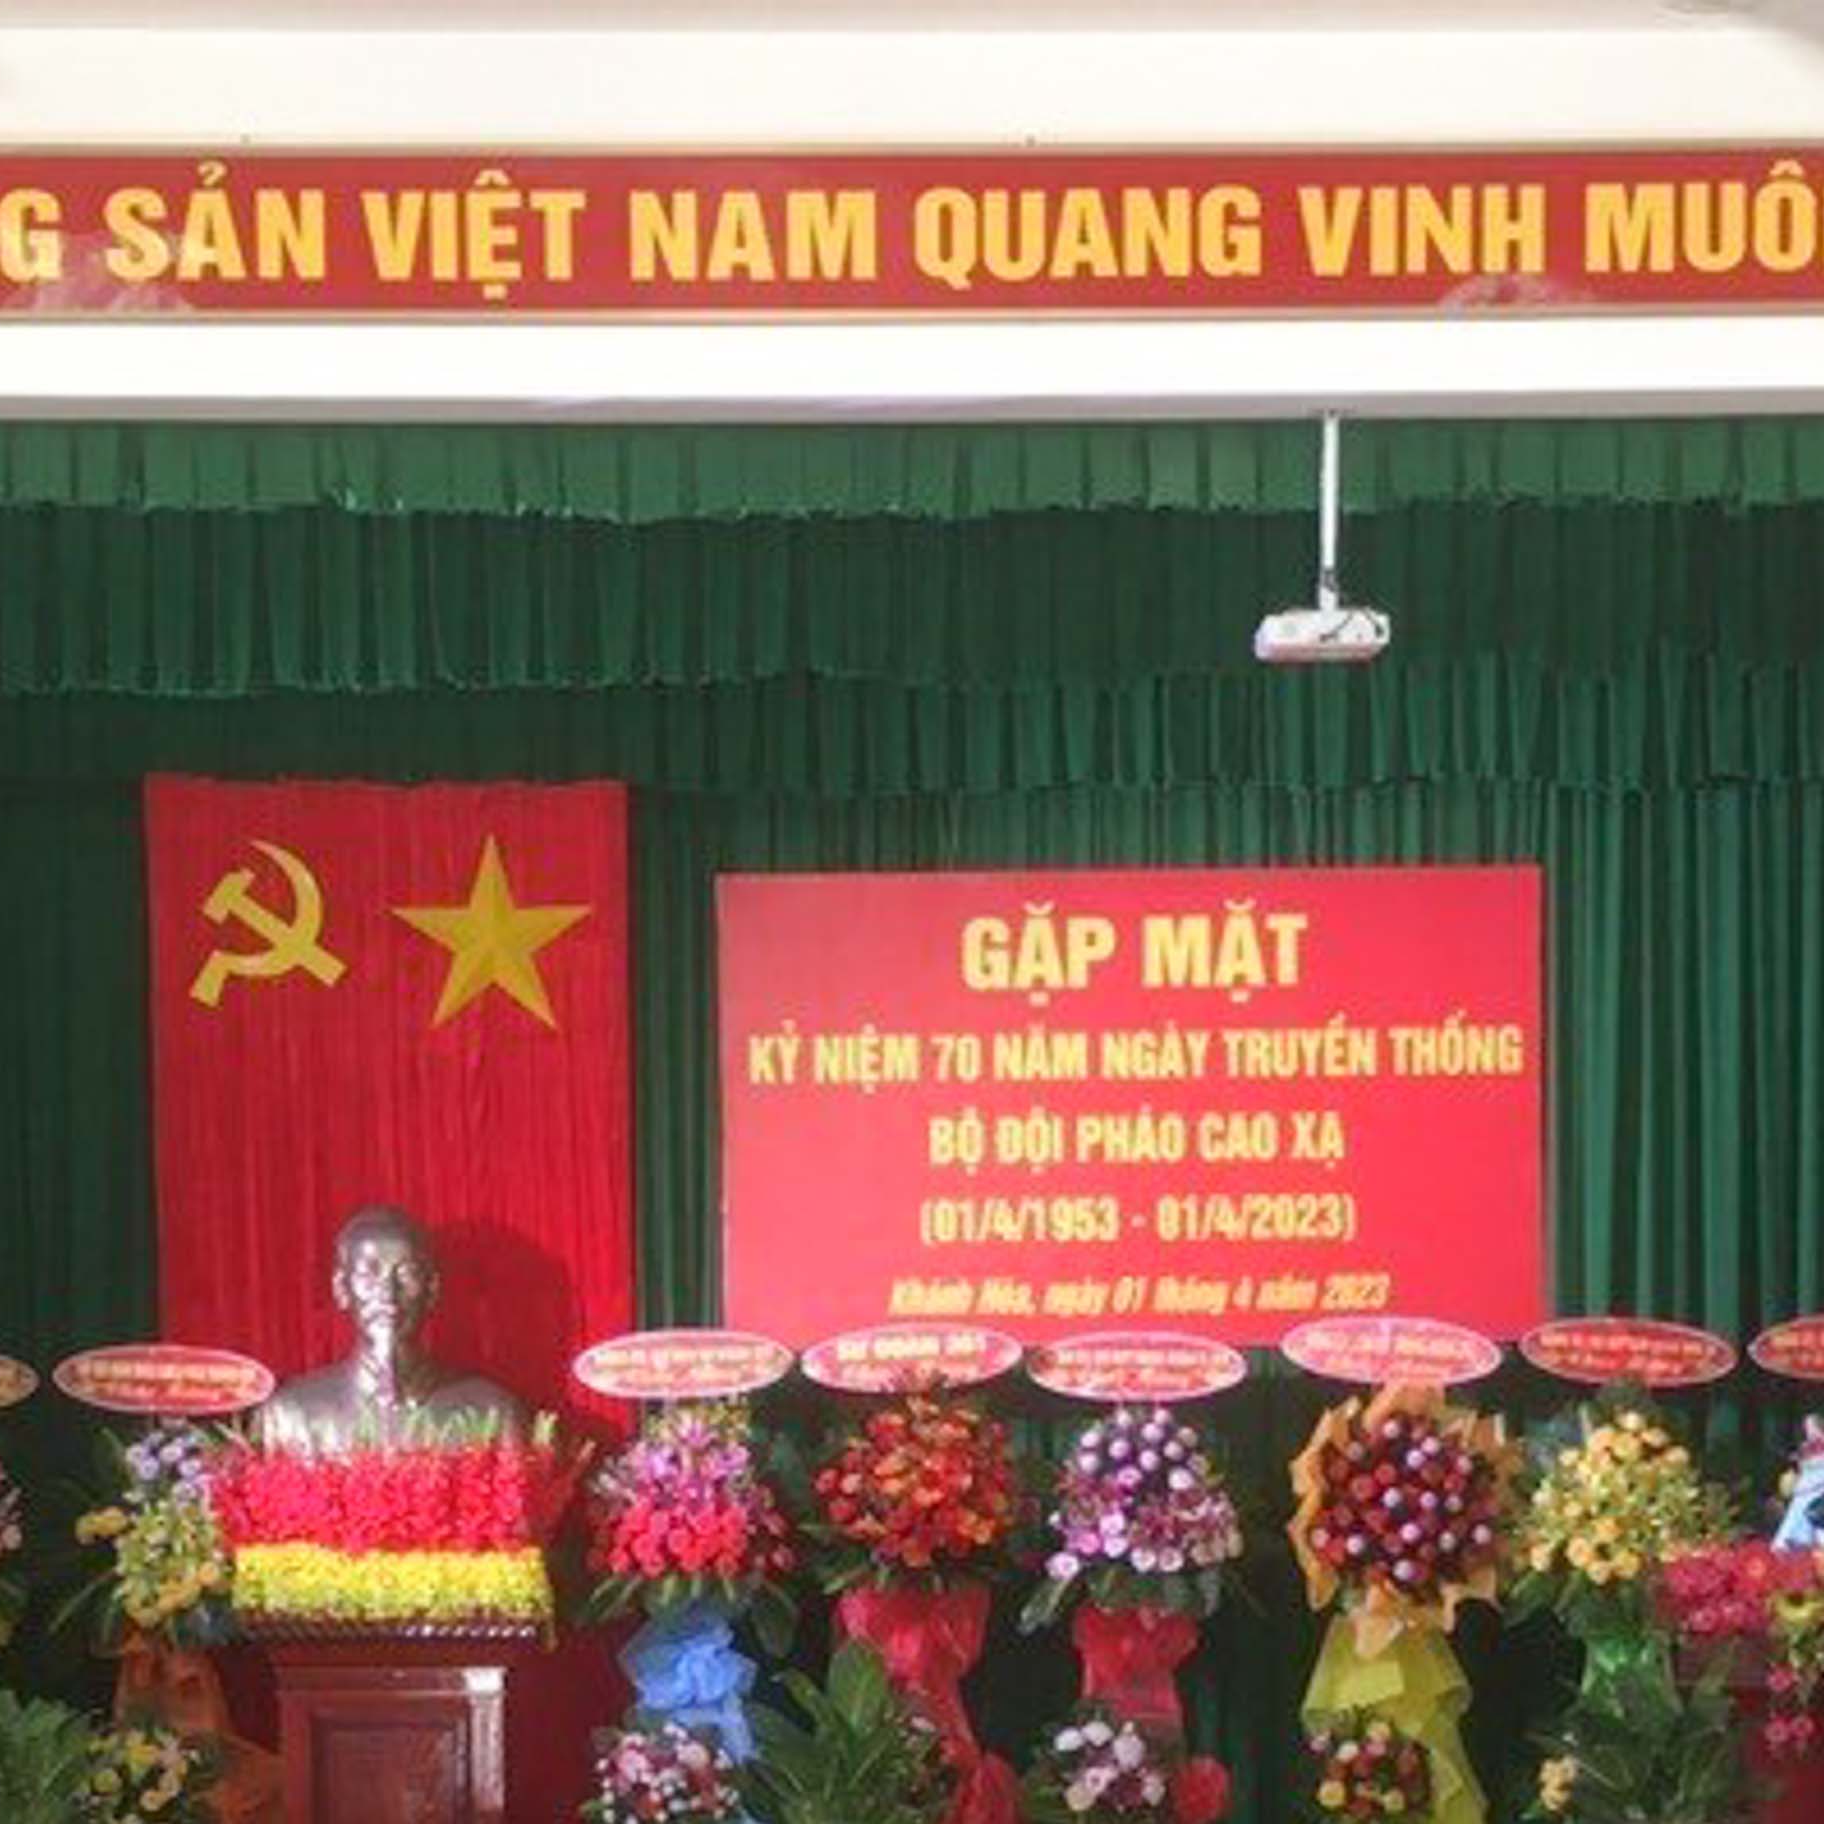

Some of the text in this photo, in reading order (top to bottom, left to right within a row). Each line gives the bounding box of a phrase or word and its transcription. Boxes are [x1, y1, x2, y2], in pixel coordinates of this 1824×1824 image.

[103, 157, 327, 283] SẢN
[361, 169, 588, 298] VIỆT
[628, 188, 879, 283] NAM
[914, 185, 1263, 290] QUANG
[1299, 183, 1547, 277] VINH
[962, 900, 1308, 1006] GẶP MẶT
[748, 1020, 801, 1084] KỶ
[812, 1023, 921, 1090] NIỆM
[931, 1033, 983, 1084] 70
[992, 1024, 1089, 1081] NĂM
[1100, 1026, 1210, 1080] NGÀY
[1389, 1017, 1522, 1076] THỐNG
[928, 1106, 1344, 1175] BỘ ĐỘI PHÁO CAO XẠ
